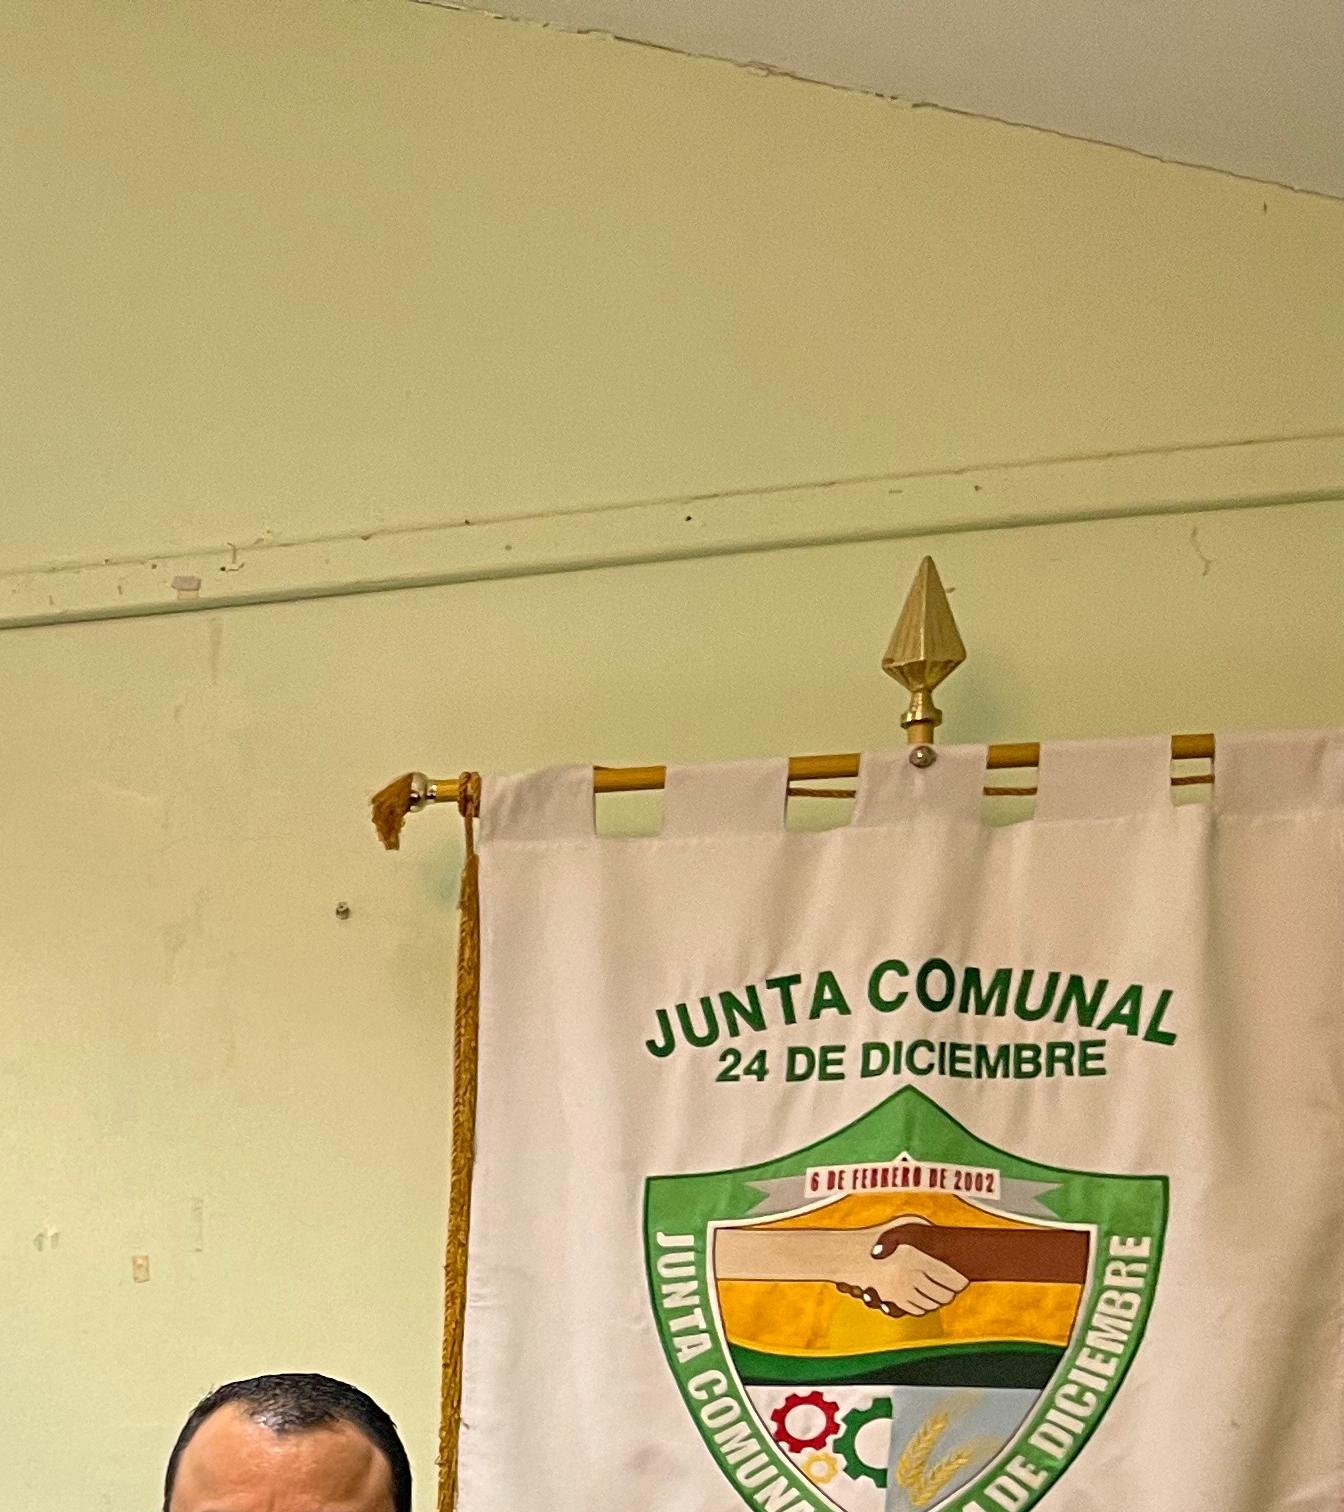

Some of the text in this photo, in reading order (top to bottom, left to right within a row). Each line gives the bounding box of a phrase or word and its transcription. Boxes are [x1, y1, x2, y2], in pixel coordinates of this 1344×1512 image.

[645, 957, 1179, 1058] JUNTA COMUNAL
[715, 1039, 1107, 1082] 24 DE DICIEMBRE
[810, 1166, 994, 1193] 6 DE FEBRERO DE 2002
[656, 1231, 712, 1364] JUNTA
[1028, 1235, 1152, 1460] DICIEMBRE
